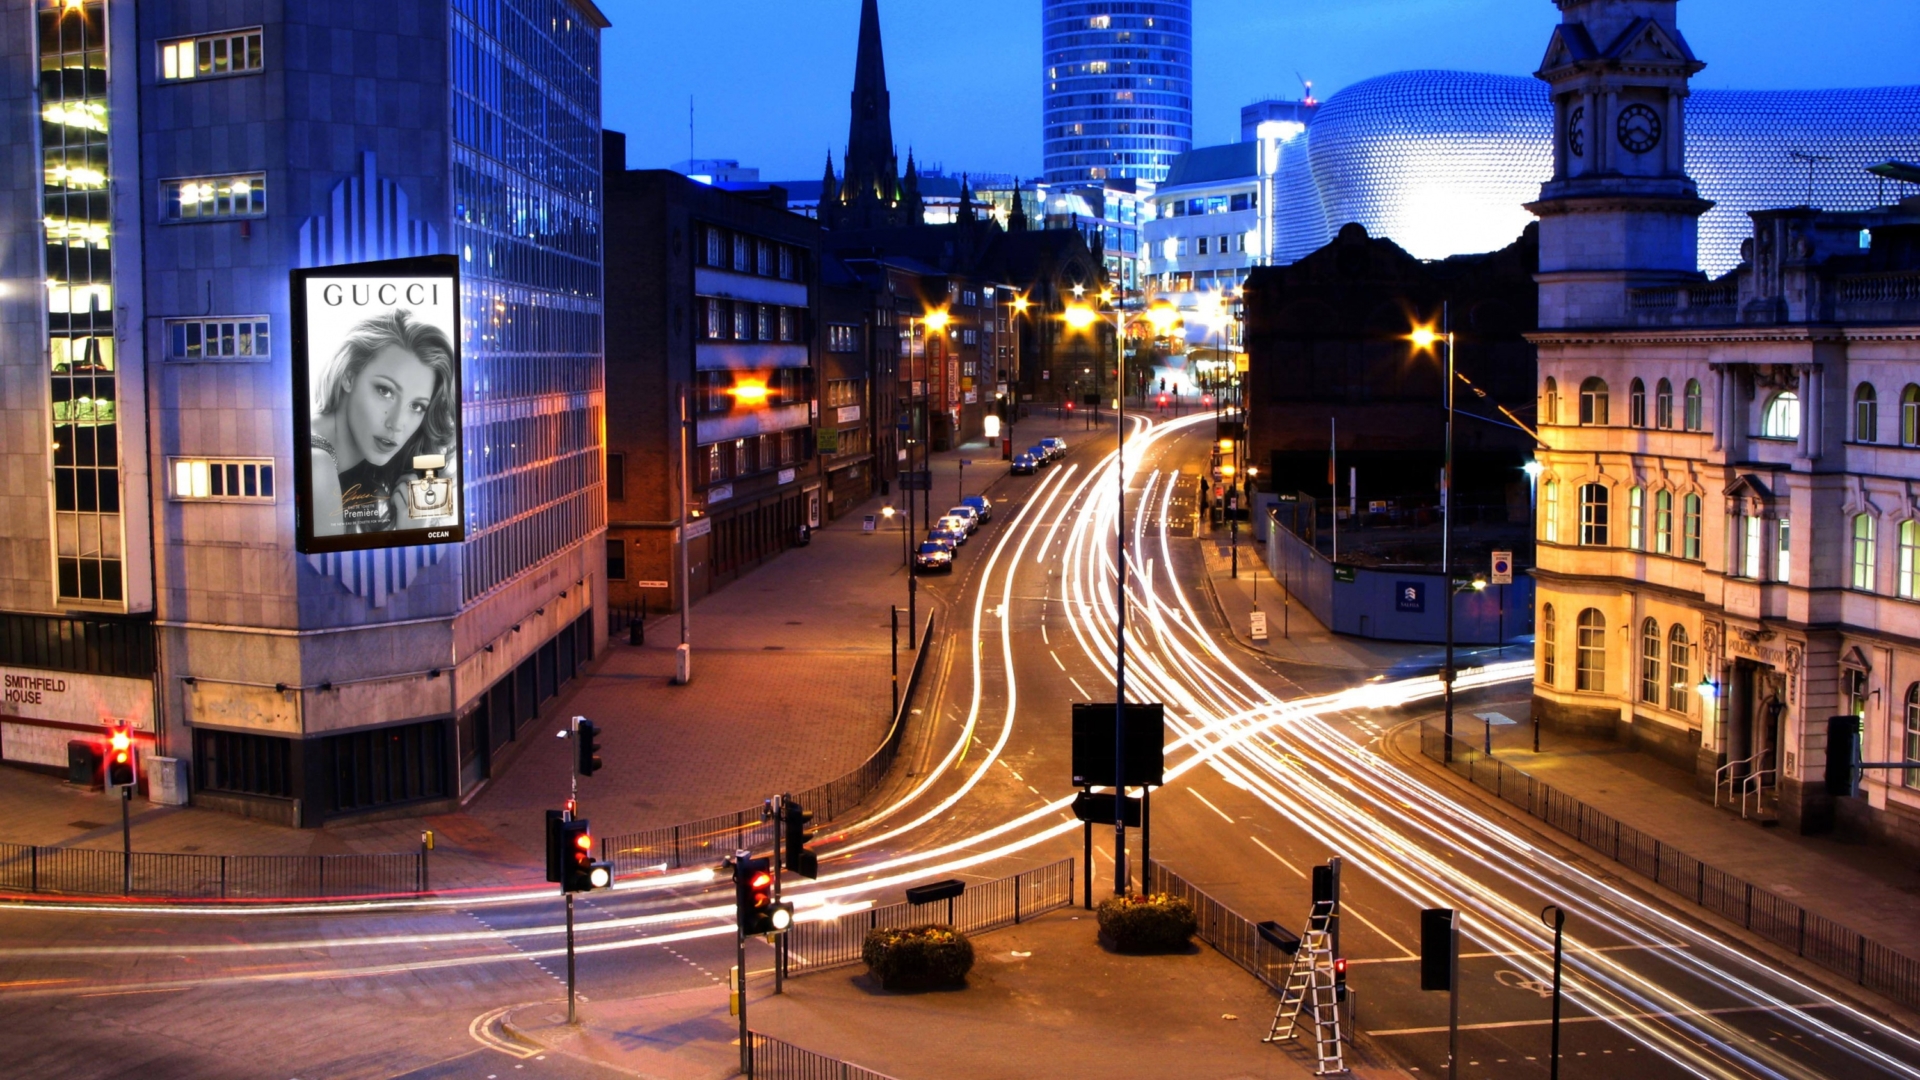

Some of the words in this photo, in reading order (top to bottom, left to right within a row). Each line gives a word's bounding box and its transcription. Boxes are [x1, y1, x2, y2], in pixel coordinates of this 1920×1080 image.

[323, 283, 438, 306] GUCCI
[344, 508, 379, 518] Première
[1728, 640, 1751, 655] POLICE
[1754, 646, 1784, 663] STATION
[5, 674, 66, 692] SMITHFIELD
[5, 689, 42, 704] HOUSE
